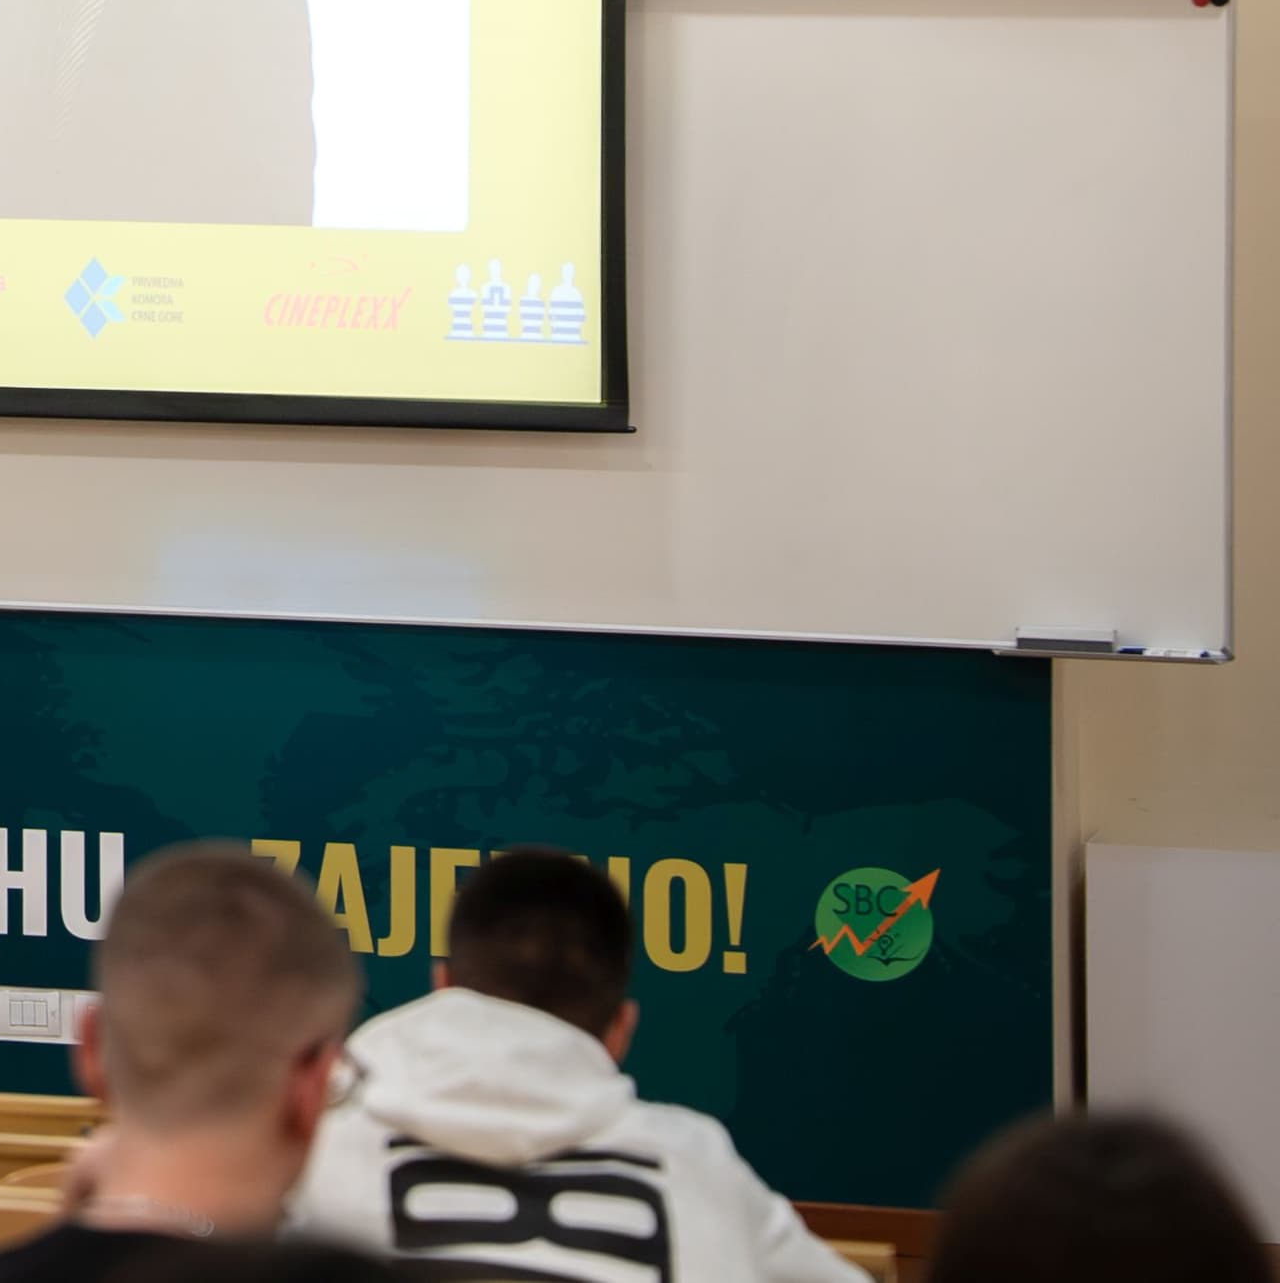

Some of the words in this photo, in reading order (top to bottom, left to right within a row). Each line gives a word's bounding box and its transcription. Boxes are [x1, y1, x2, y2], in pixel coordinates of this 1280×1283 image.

[131, 310, 156, 322] CRNE
[158, 311, 185, 324] GORE
[263, 286, 413, 332] CINEPLEXX
[831, 881, 900, 919] SBC
